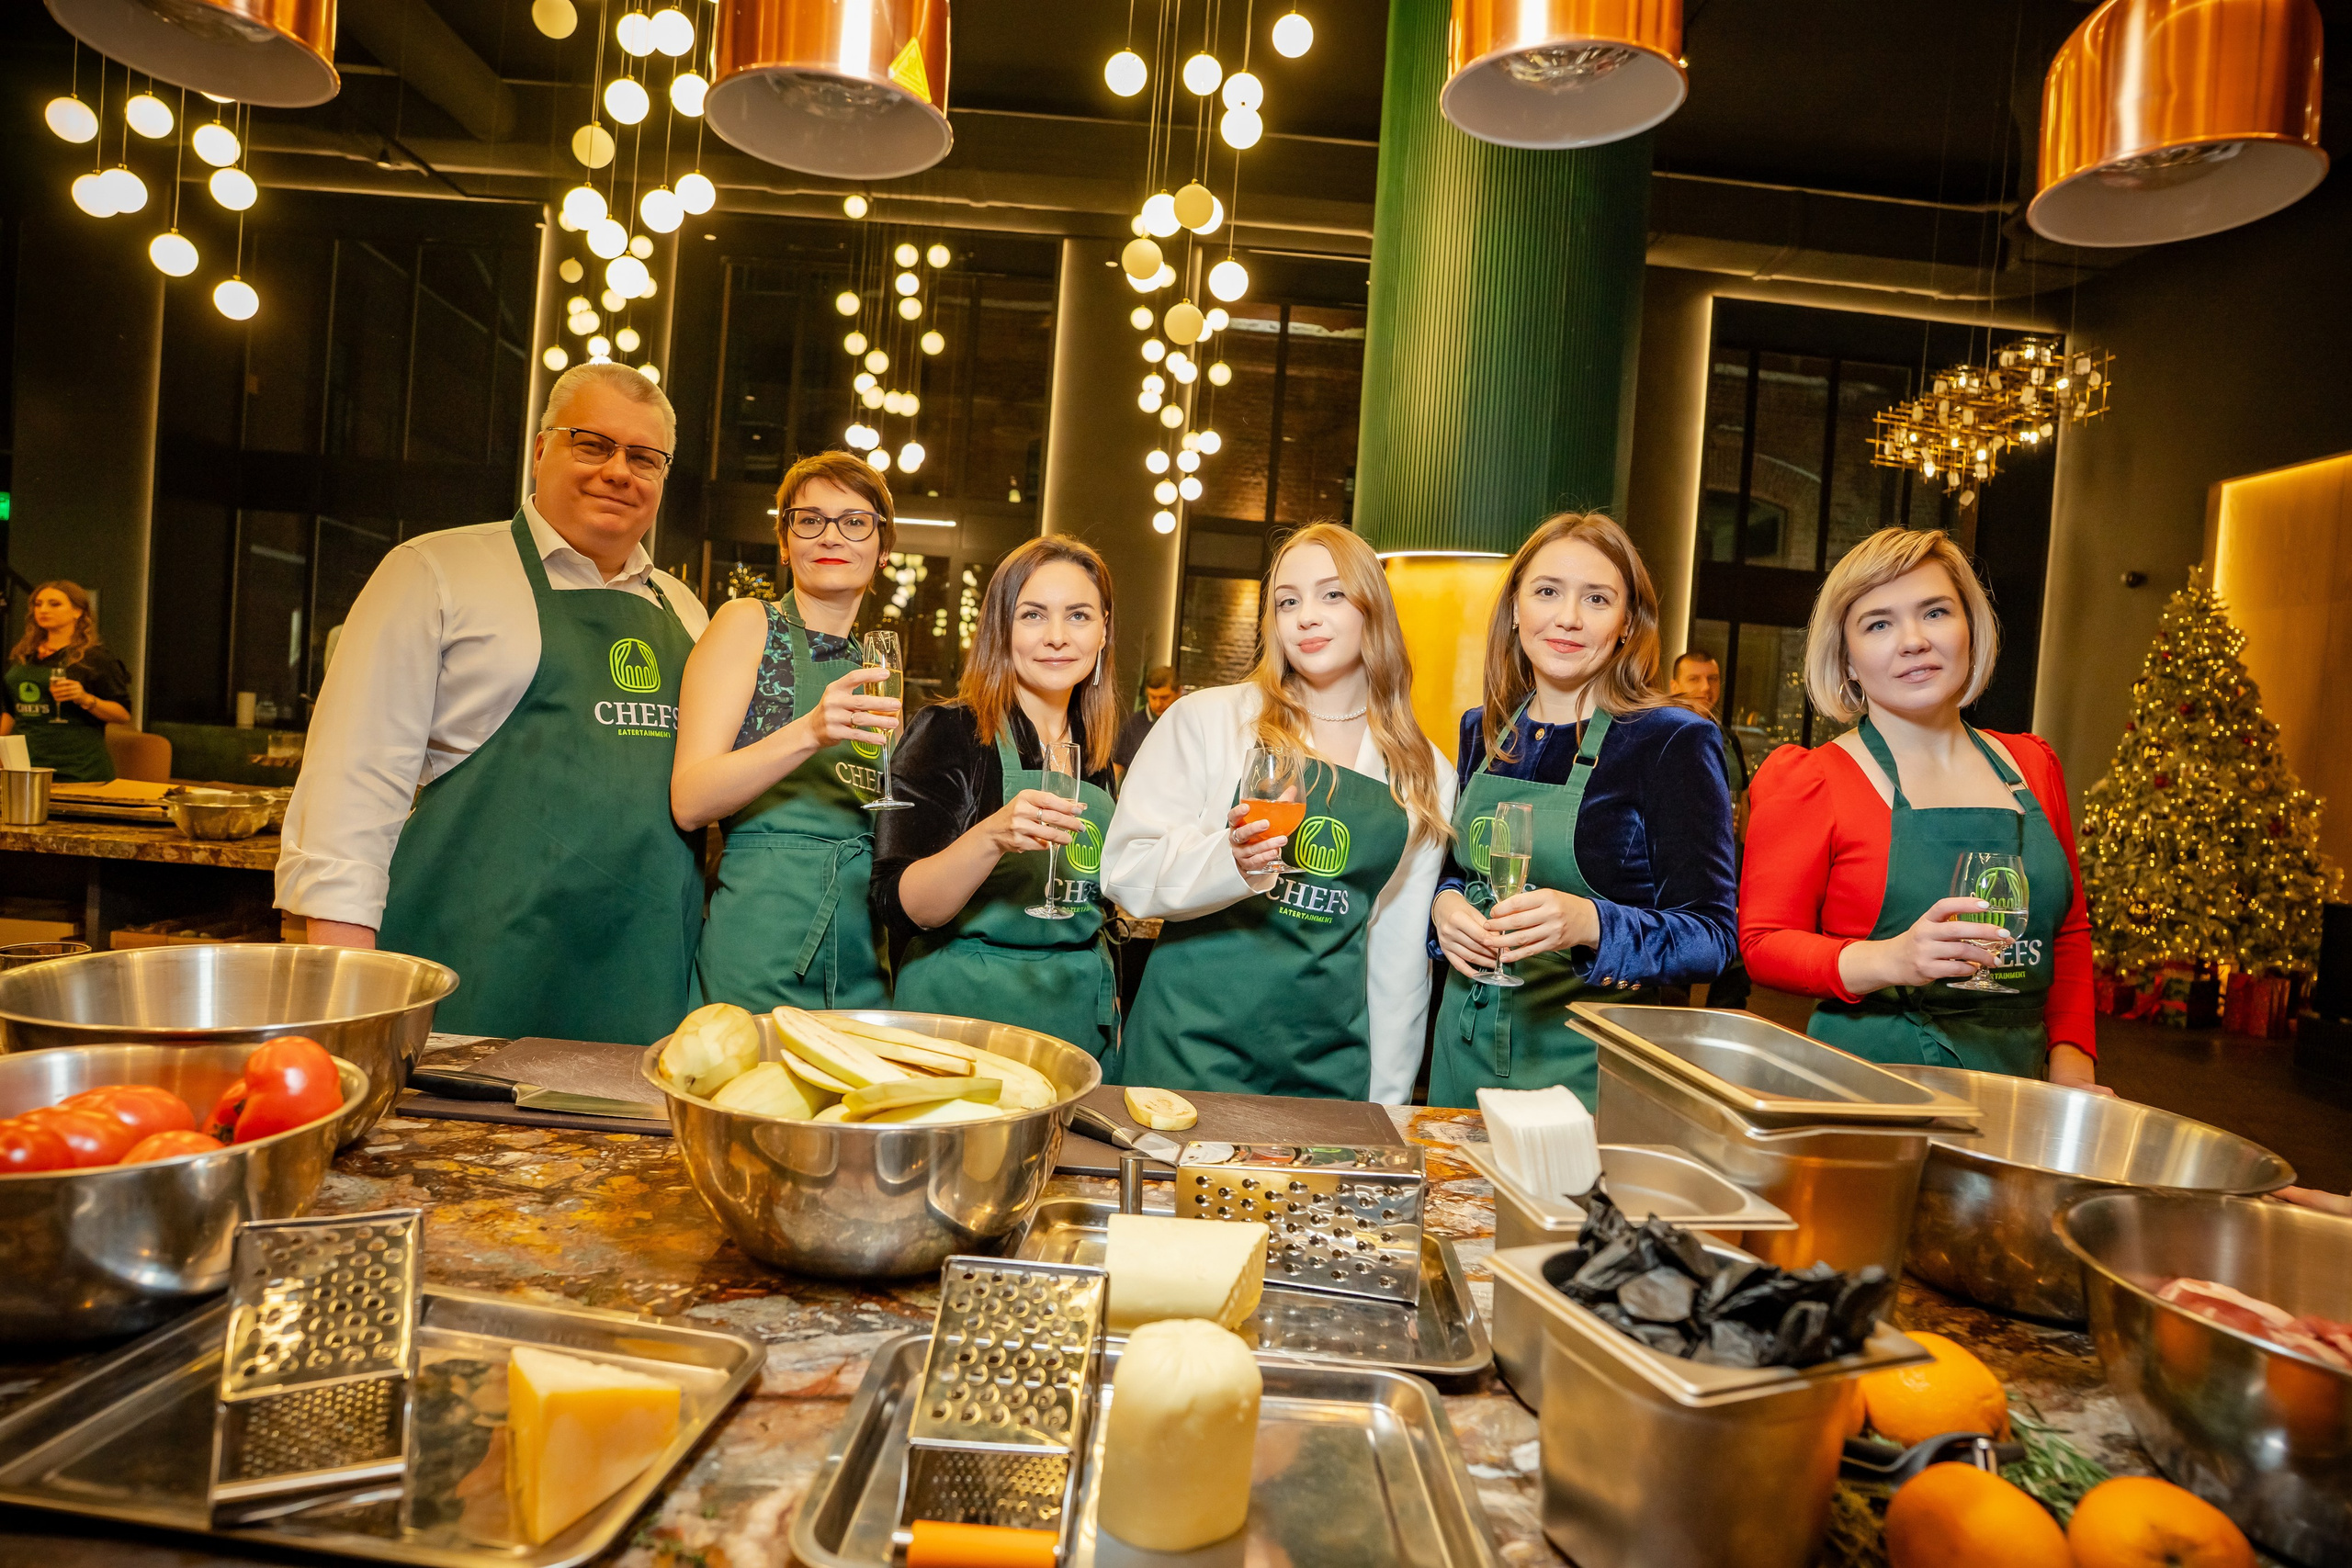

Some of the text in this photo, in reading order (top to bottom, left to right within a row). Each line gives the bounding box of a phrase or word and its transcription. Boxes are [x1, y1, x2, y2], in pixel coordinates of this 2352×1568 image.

[1265, 876, 1350, 915] CHEFS
[1278, 906, 1333, 924] EATERTAINMENT
[1996, 939, 2043, 968] EFS
